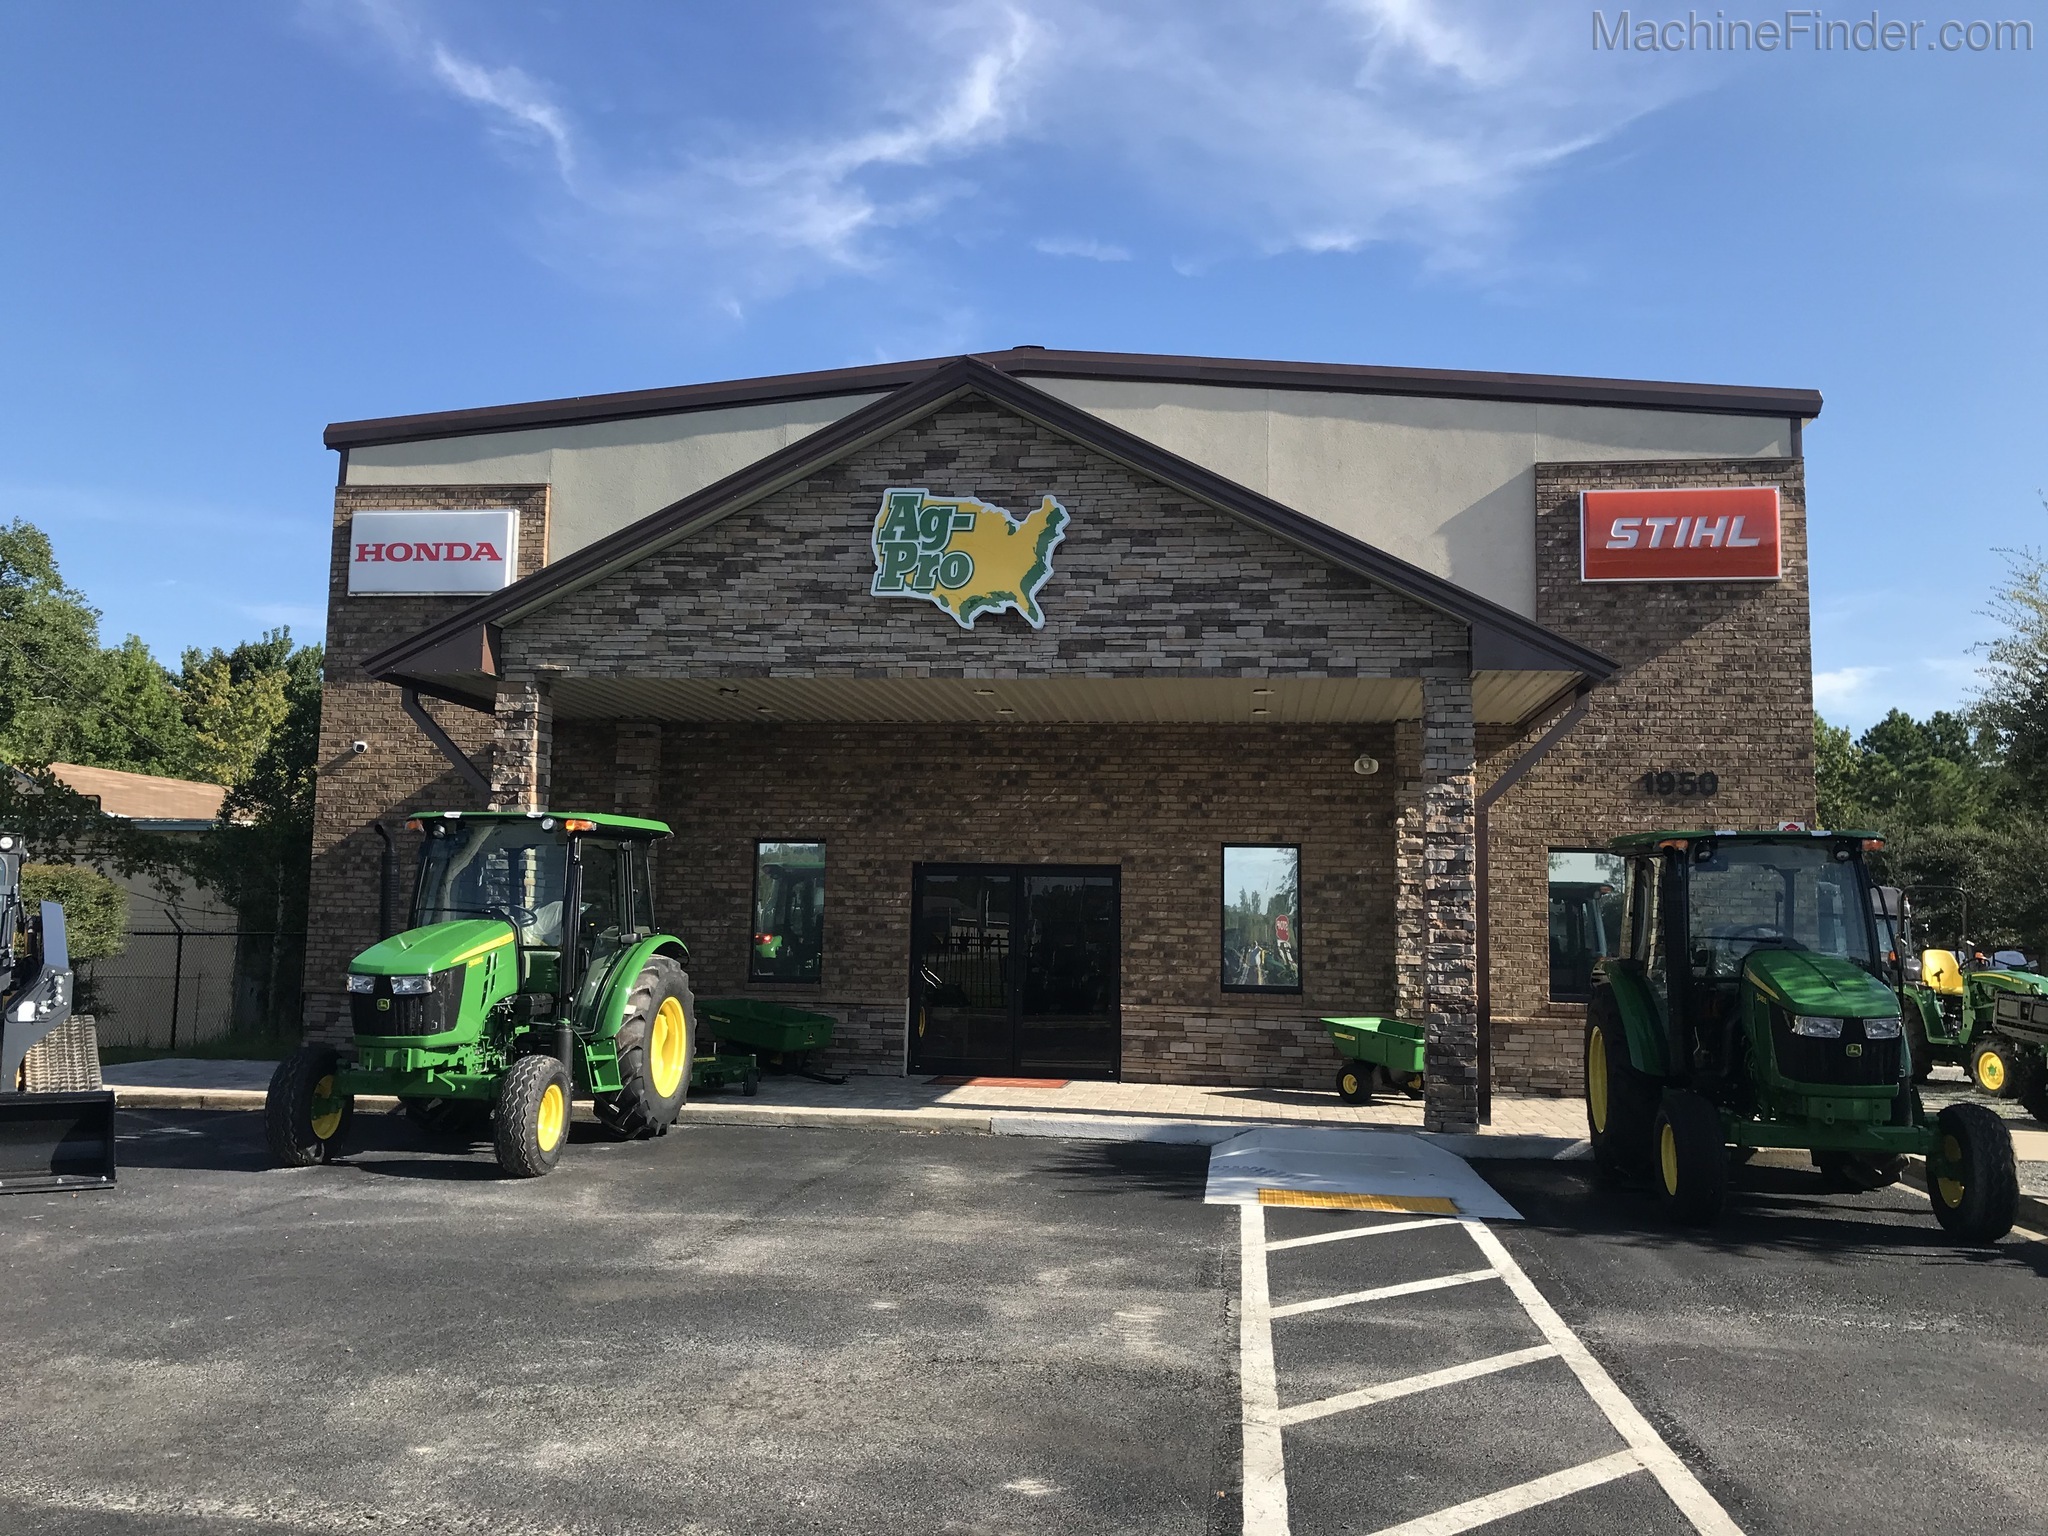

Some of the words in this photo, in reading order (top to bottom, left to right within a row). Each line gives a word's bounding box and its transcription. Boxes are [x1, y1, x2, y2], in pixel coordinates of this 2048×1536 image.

[878, 492, 976, 551] Ag-
[1606, 515, 1760, 549] STIHL
[354, 542, 503, 562] HONDA
[876, 541, 974, 591] Pro
[1644, 771, 1718, 796] 1950
